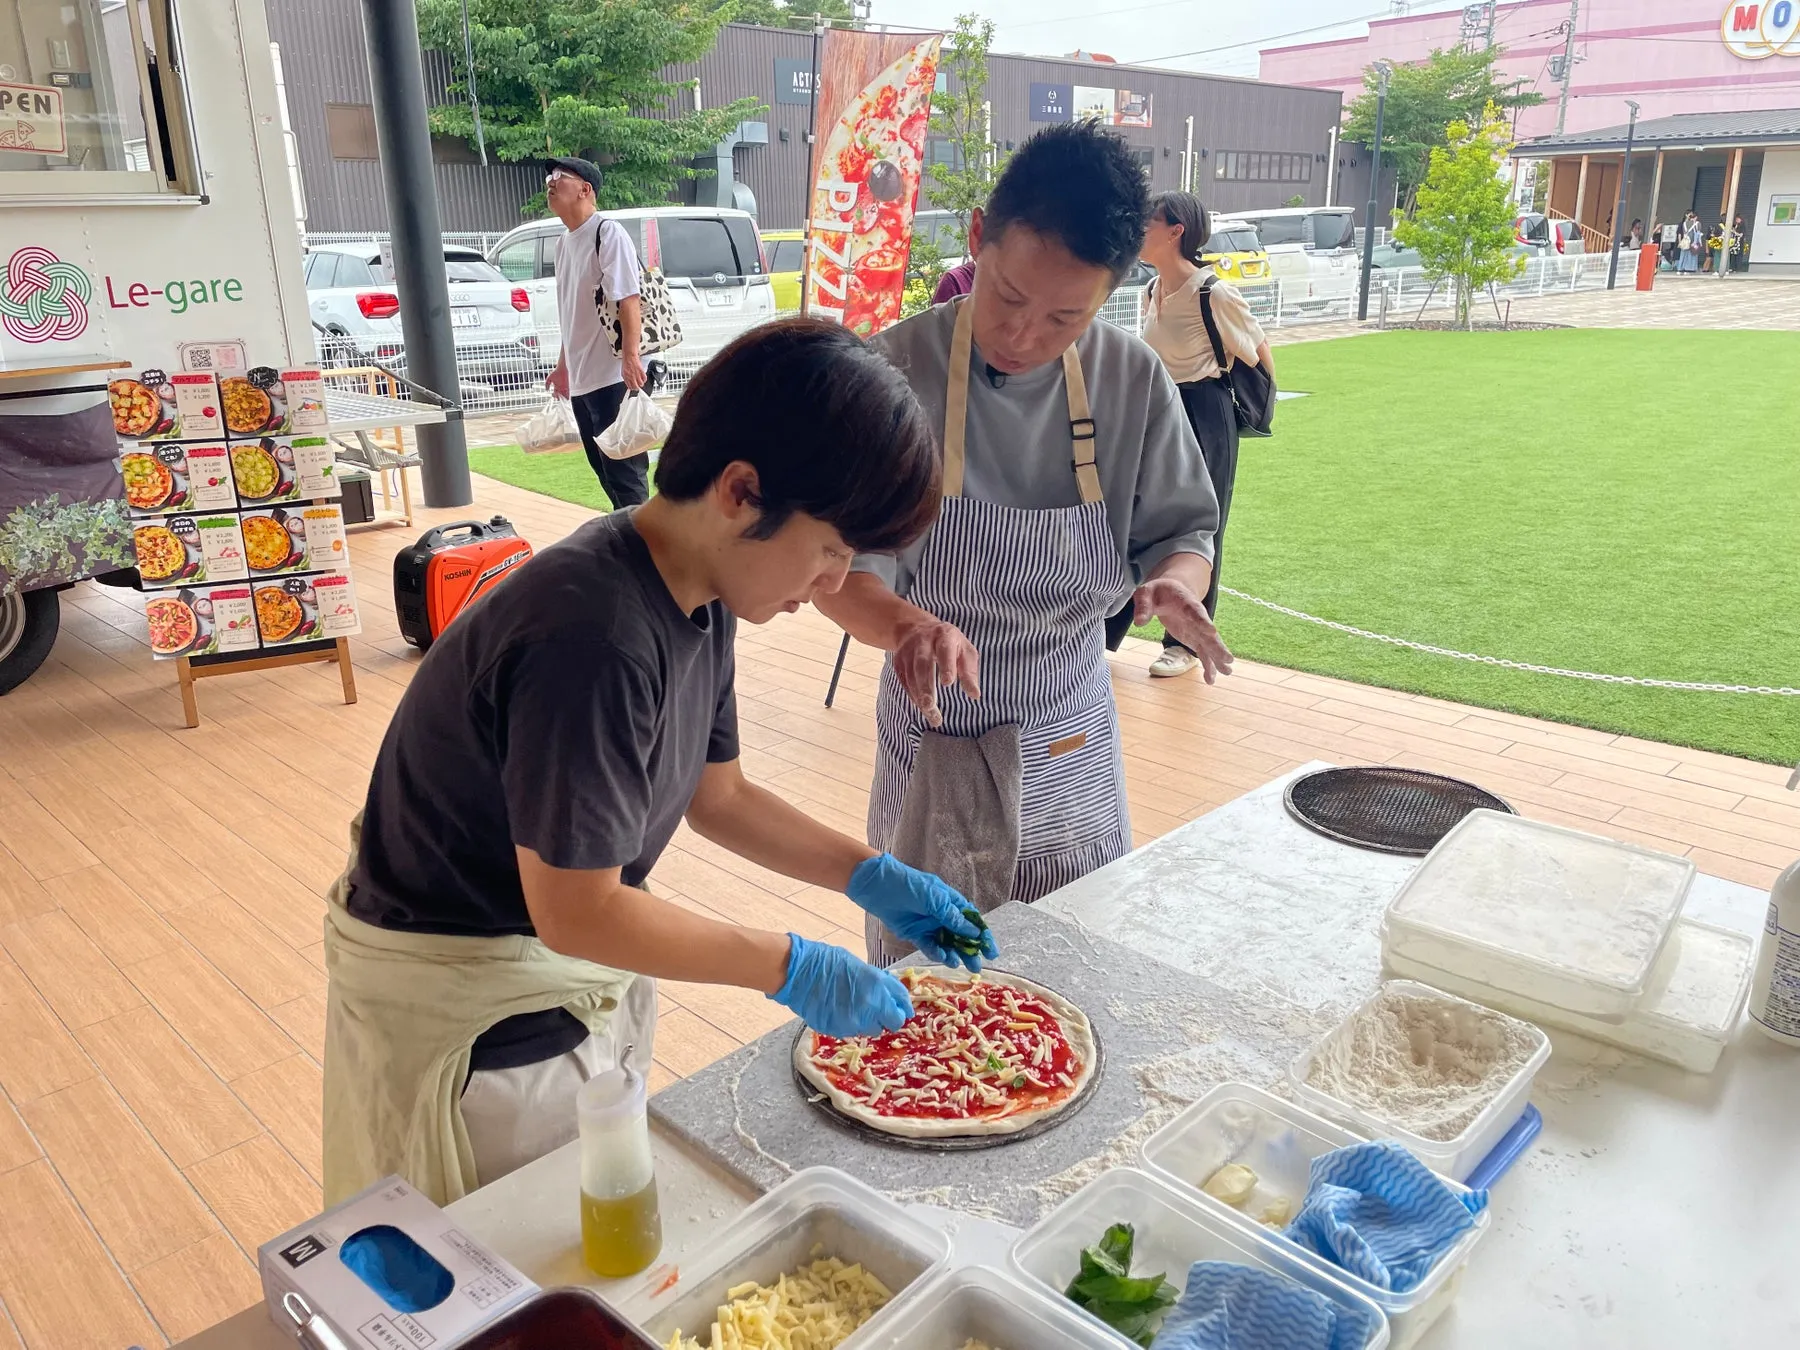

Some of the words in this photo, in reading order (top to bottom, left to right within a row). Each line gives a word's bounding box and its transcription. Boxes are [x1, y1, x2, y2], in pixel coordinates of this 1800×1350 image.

[105, 276, 243, 314] Le-gare
[444, 568, 472, 582] KOSHIN
[289, 1241, 317, 1262] M
